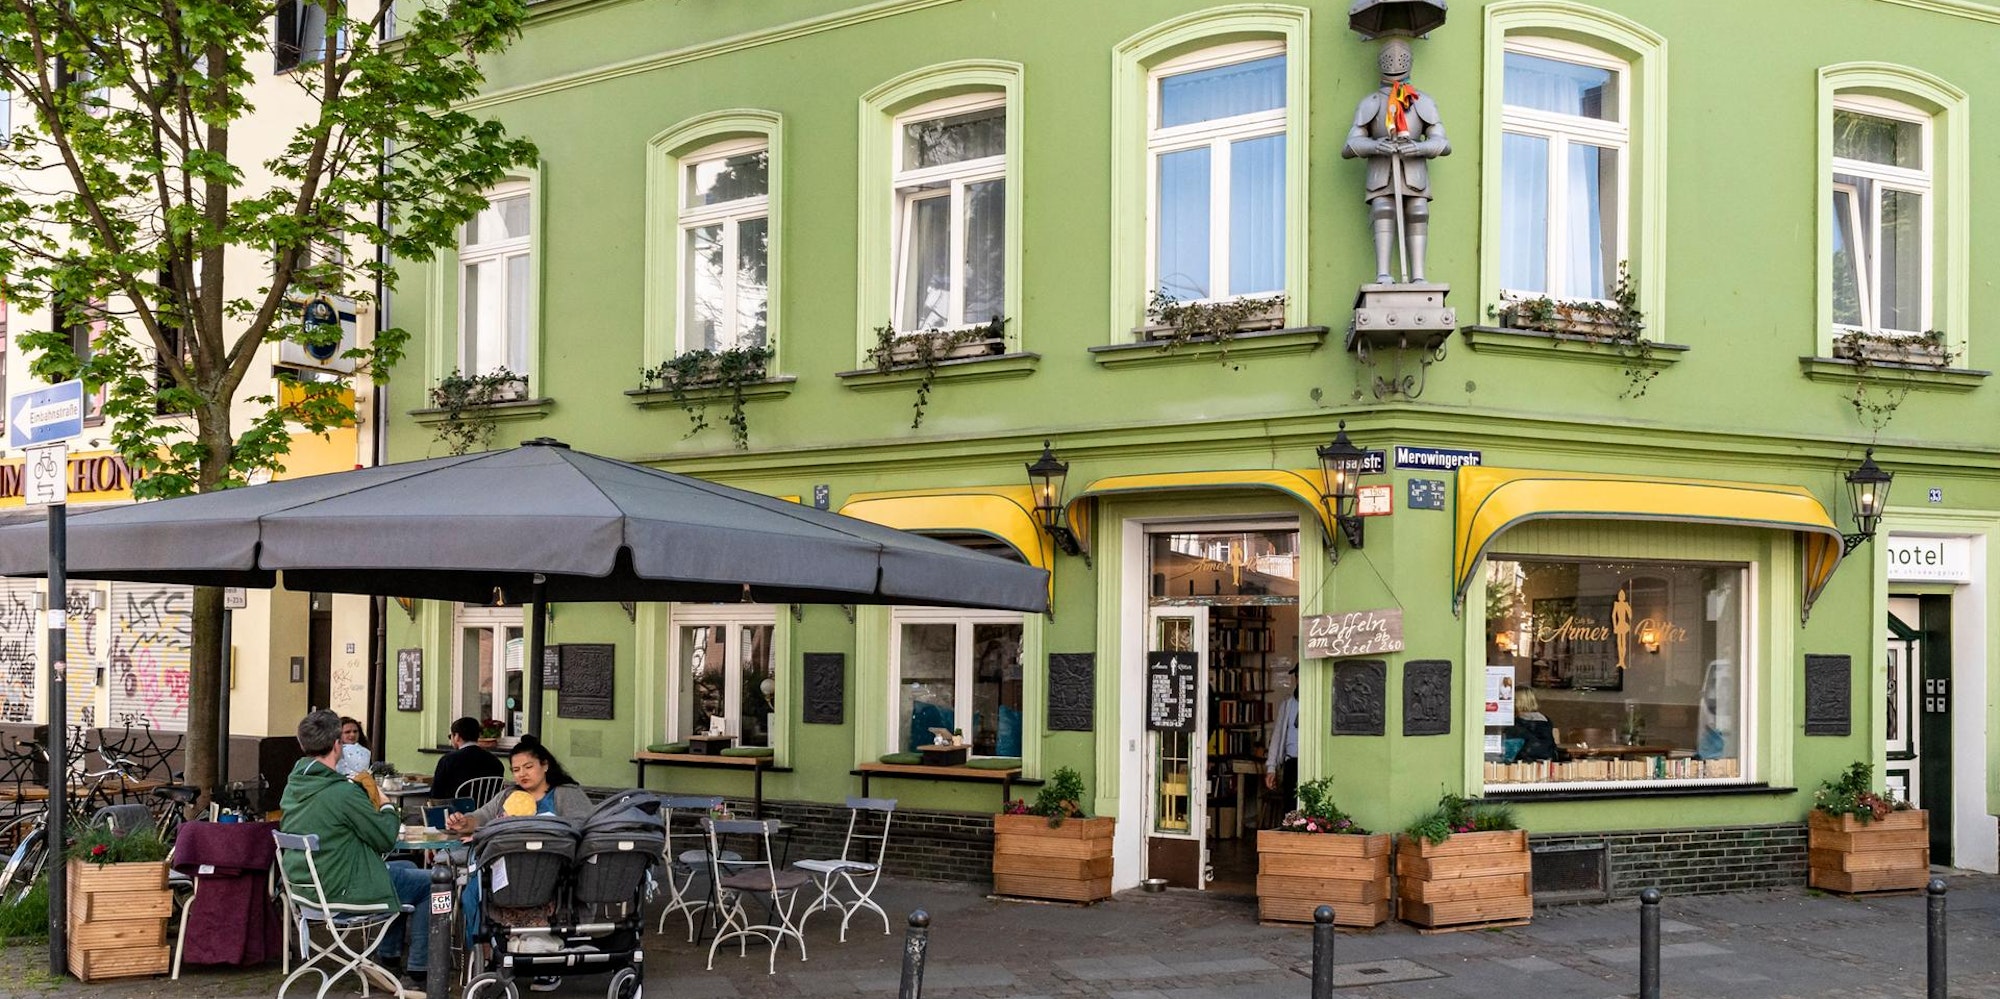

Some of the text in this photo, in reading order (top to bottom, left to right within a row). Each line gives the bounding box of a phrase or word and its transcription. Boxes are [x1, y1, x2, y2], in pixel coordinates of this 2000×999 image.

[30, 403, 78, 424] Einbahnstraße
[1309, 612, 1387, 639] Waffeln
[1538, 616, 1610, 643] Armer
[1307, 631, 1391, 658] am Stiel ab
